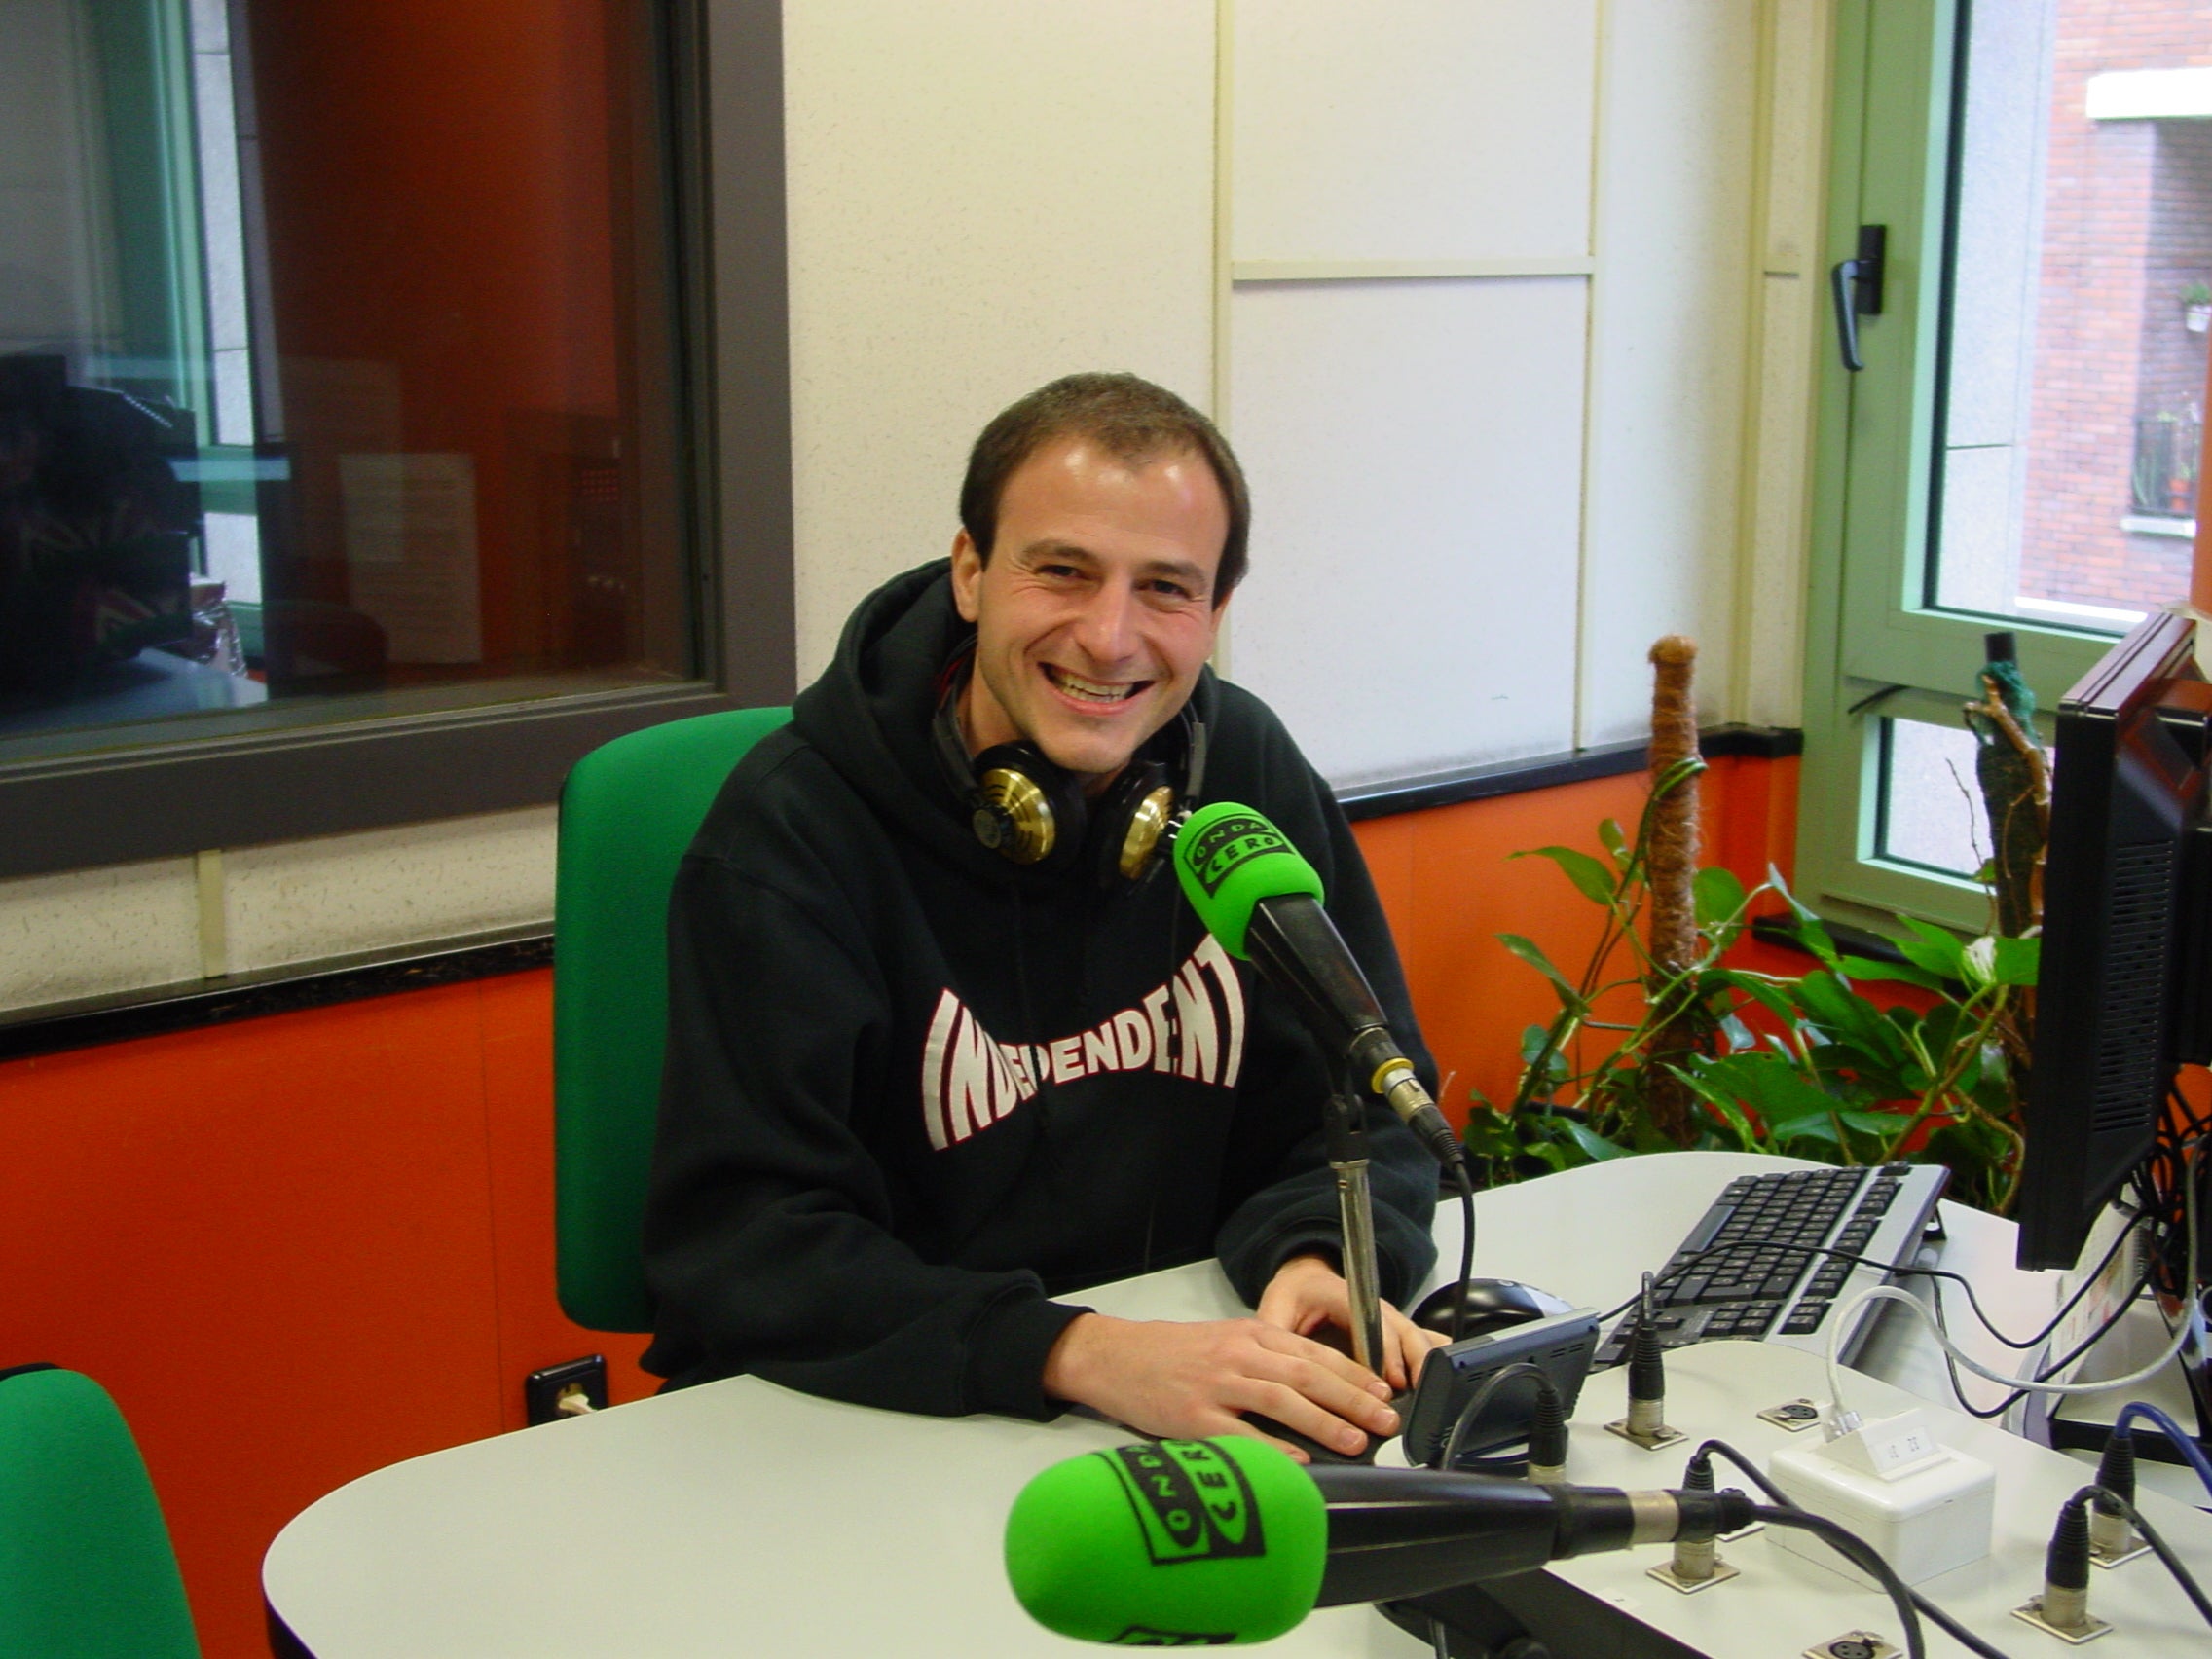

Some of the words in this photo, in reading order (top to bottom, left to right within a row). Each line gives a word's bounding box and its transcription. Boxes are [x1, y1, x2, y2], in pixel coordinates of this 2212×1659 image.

[1196, 821, 1263, 858] ONDA
[1211, 837, 1274, 872] CERO
[921, 932, 1246, 1152] INDEPENDENT
